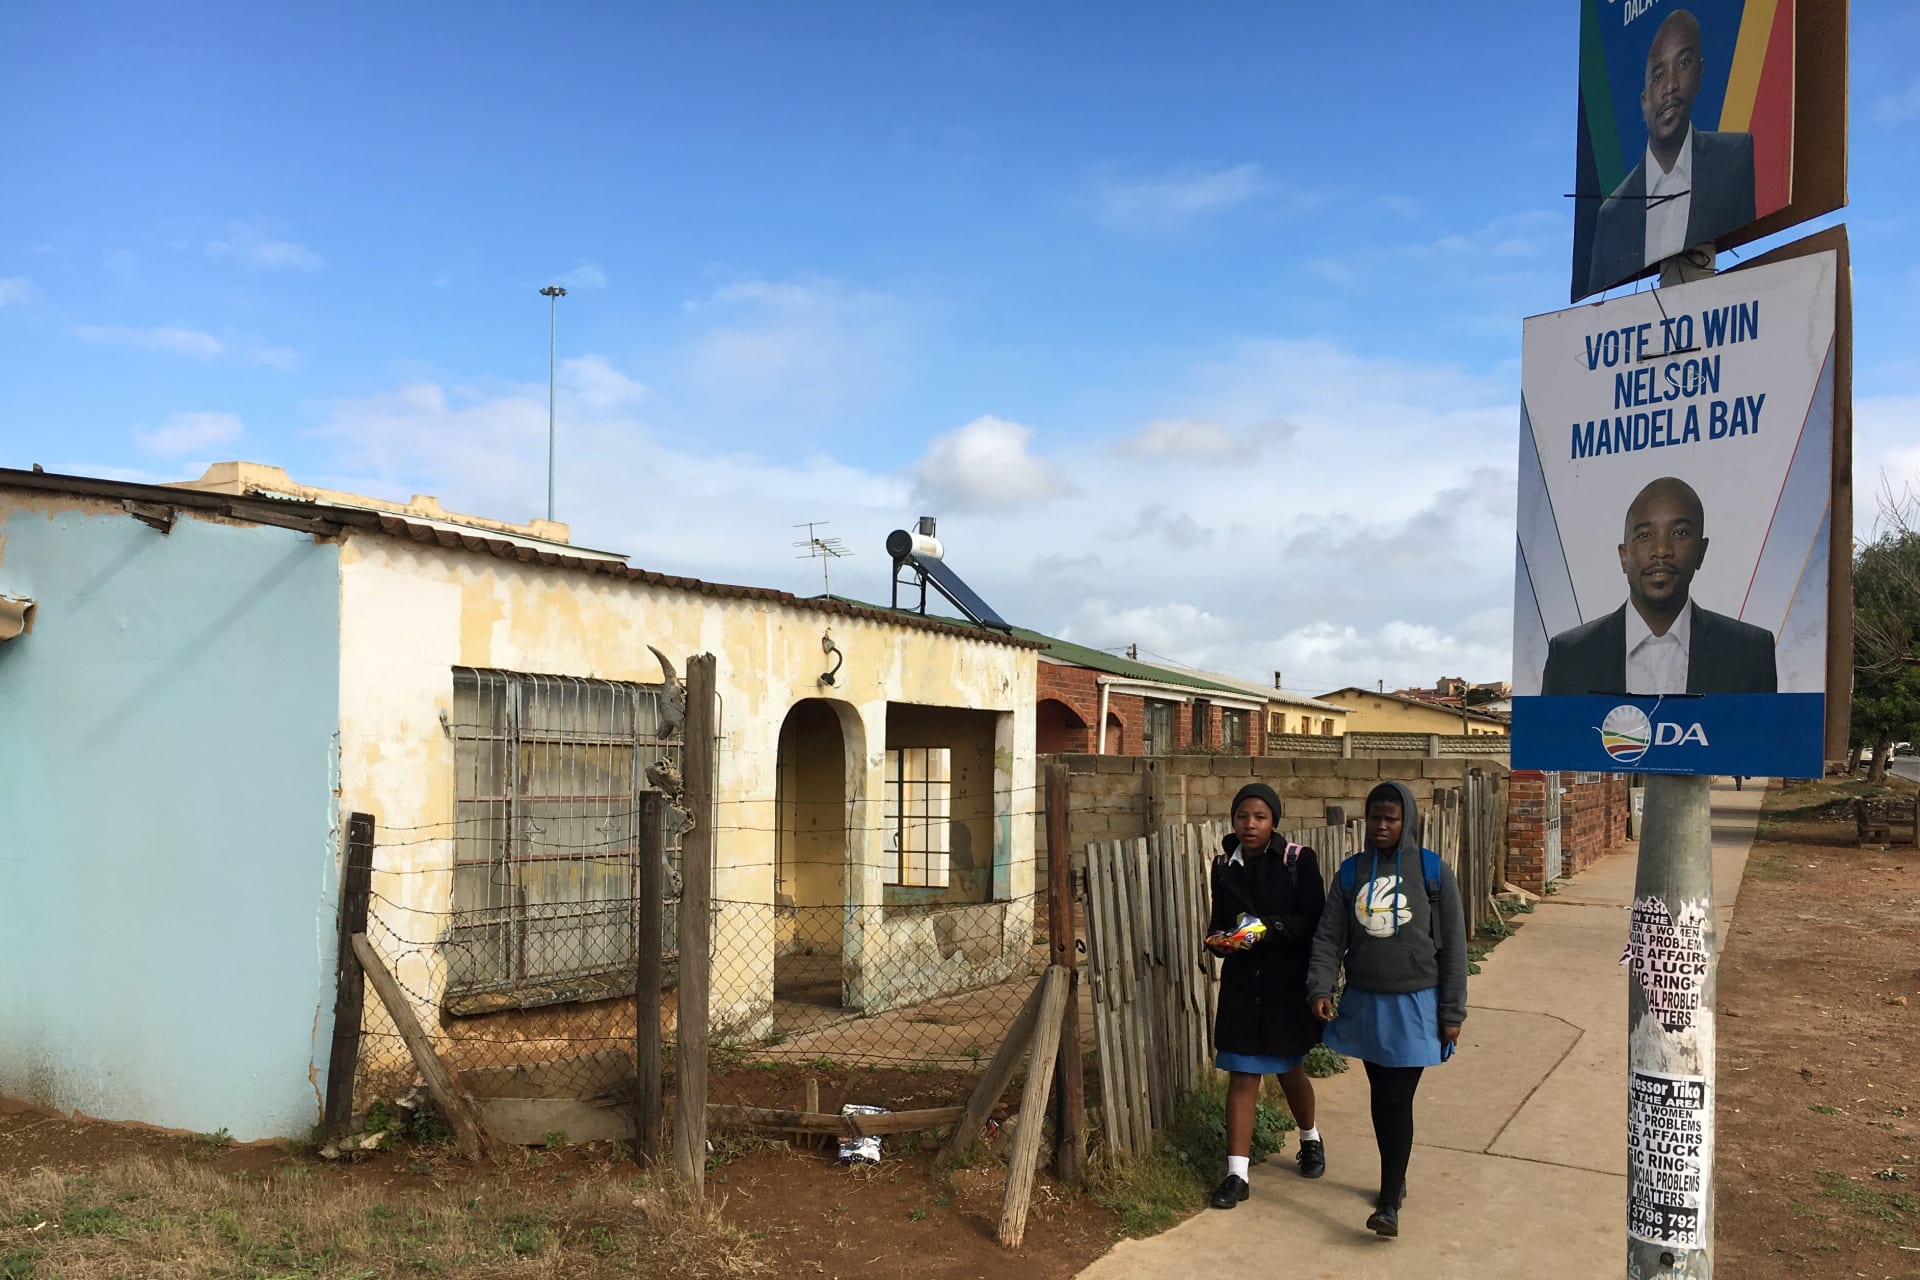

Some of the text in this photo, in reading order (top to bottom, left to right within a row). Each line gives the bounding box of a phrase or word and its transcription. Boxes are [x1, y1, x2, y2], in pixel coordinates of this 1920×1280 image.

[1585, 300, 1759, 371] VOTE TO WIN
[1614, 354, 1721, 410] NELSON
[1571, 393, 1766, 460] MANDELA BAY
[1654, 722, 1709, 746] DA
[1643, 914, 1669, 925] THE
[1645, 925, 1652, 934] &
[1650, 960, 1706, 975] LUCK
[1662, 991, 1699, 1010] PROBLE
[1638, 1092, 1662, 1105] THE
[1665, 1098, 1700, 1109] AREA
[1651, 1105, 1693, 1119] WOMEN
[1645, 1113, 1702, 1132] PROBLEMS
[1642, 1127, 1703, 1145] AFFAIRS
[1646, 1139, 1700, 1157] LUCK
[1656, 1171, 1701, 1193] PROBLEMS
[1635, 1198, 1656, 1210] CALL
[1637, 1184, 1685, 1208] MATTERS
[1632, 1205, 1697, 1229] 3796 792
[1668, 1230, 1697, 1244] 269
